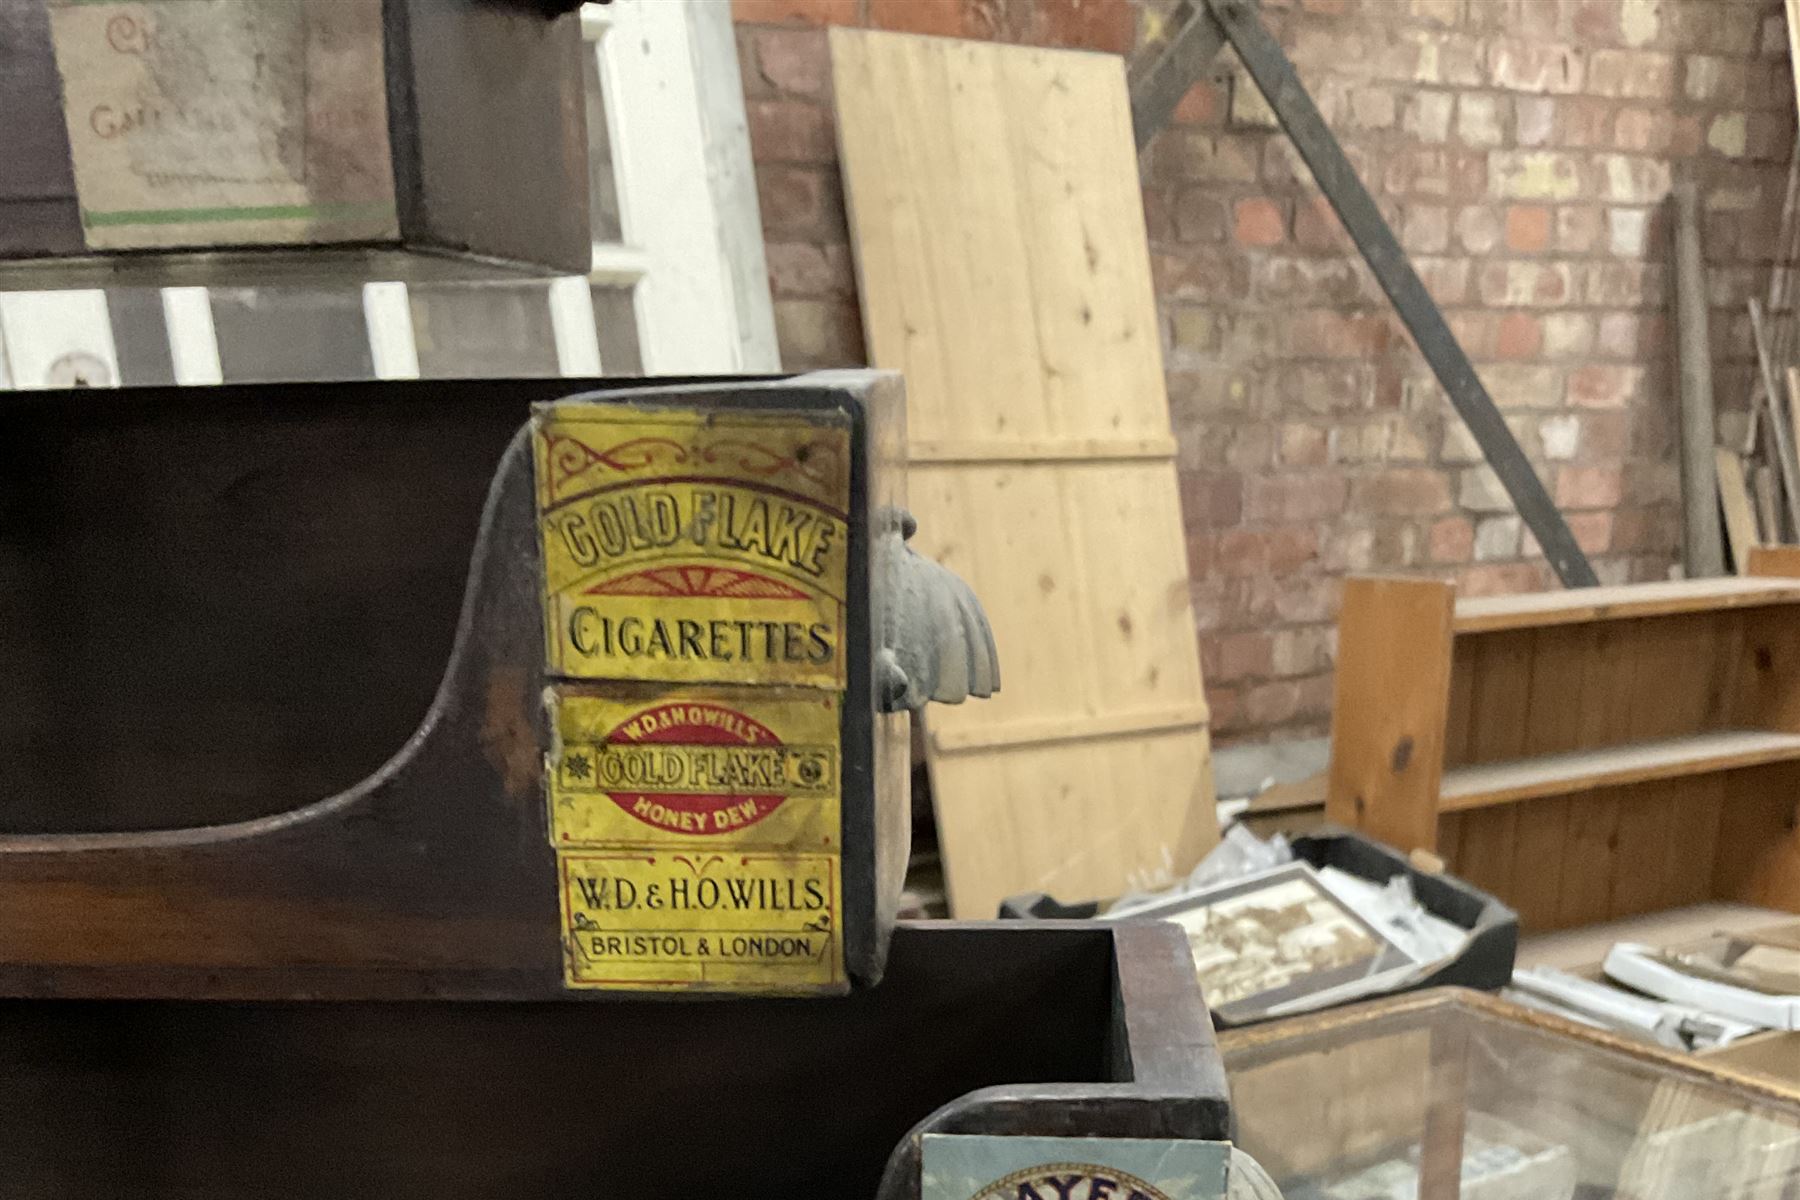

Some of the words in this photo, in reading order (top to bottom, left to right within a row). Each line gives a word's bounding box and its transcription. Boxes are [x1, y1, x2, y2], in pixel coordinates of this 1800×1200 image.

[558, 493, 680, 568] GOLD
[691, 490, 835, 577] FLAKE
[600, 751, 684, 785] GOLD
[689, 751, 785, 787] FLAKE
[632, 796, 707, 831] HONEY
[591, 936, 692, 957] BRISTOL
[698, 939, 710, 956] &
